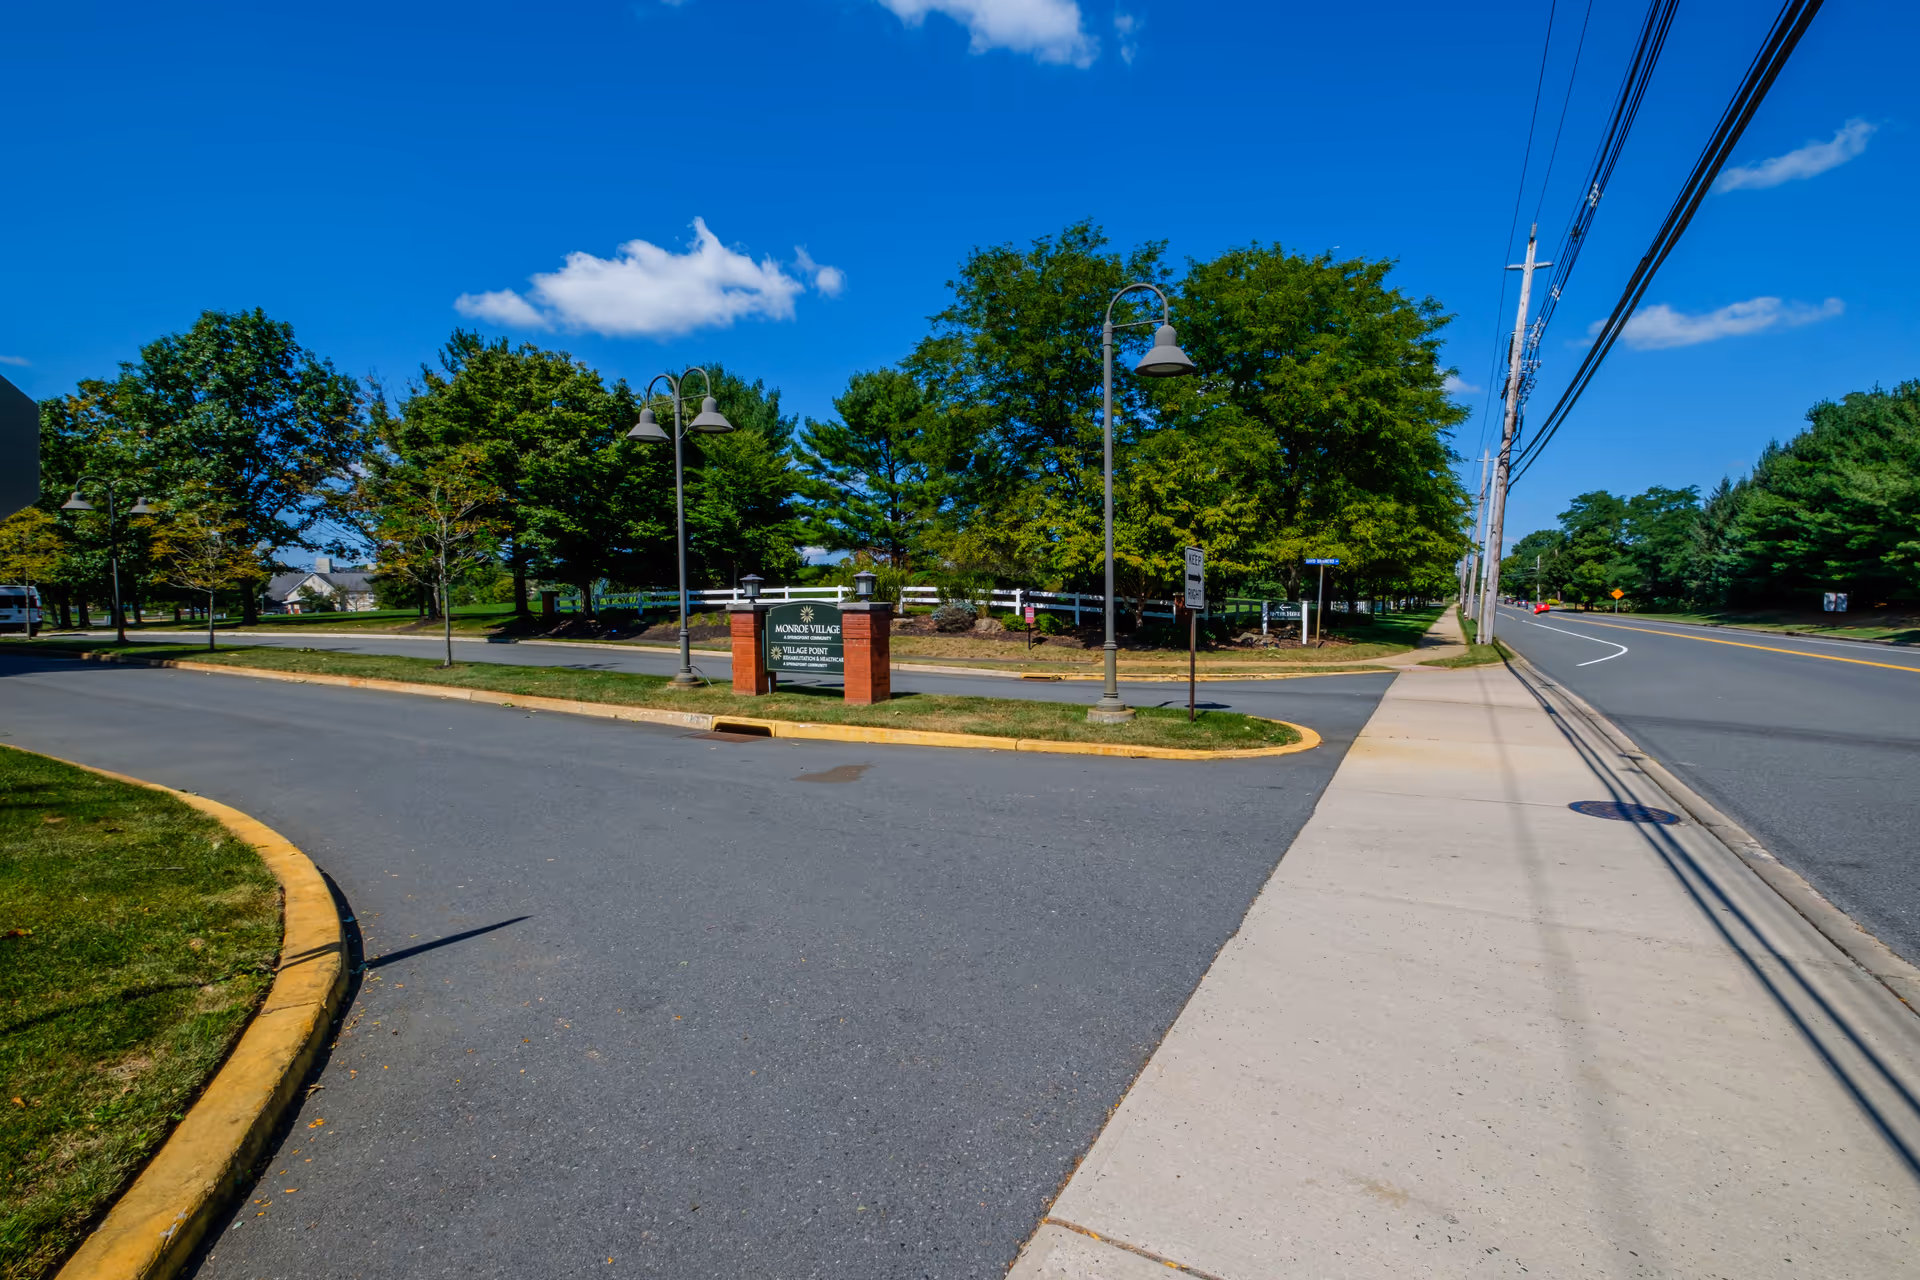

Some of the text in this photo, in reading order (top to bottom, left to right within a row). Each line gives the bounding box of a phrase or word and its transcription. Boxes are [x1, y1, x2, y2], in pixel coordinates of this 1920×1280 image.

[775, 624, 840, 634] MONROE VILLAGE
[783, 646, 828, 655] VILLAGE POINT
